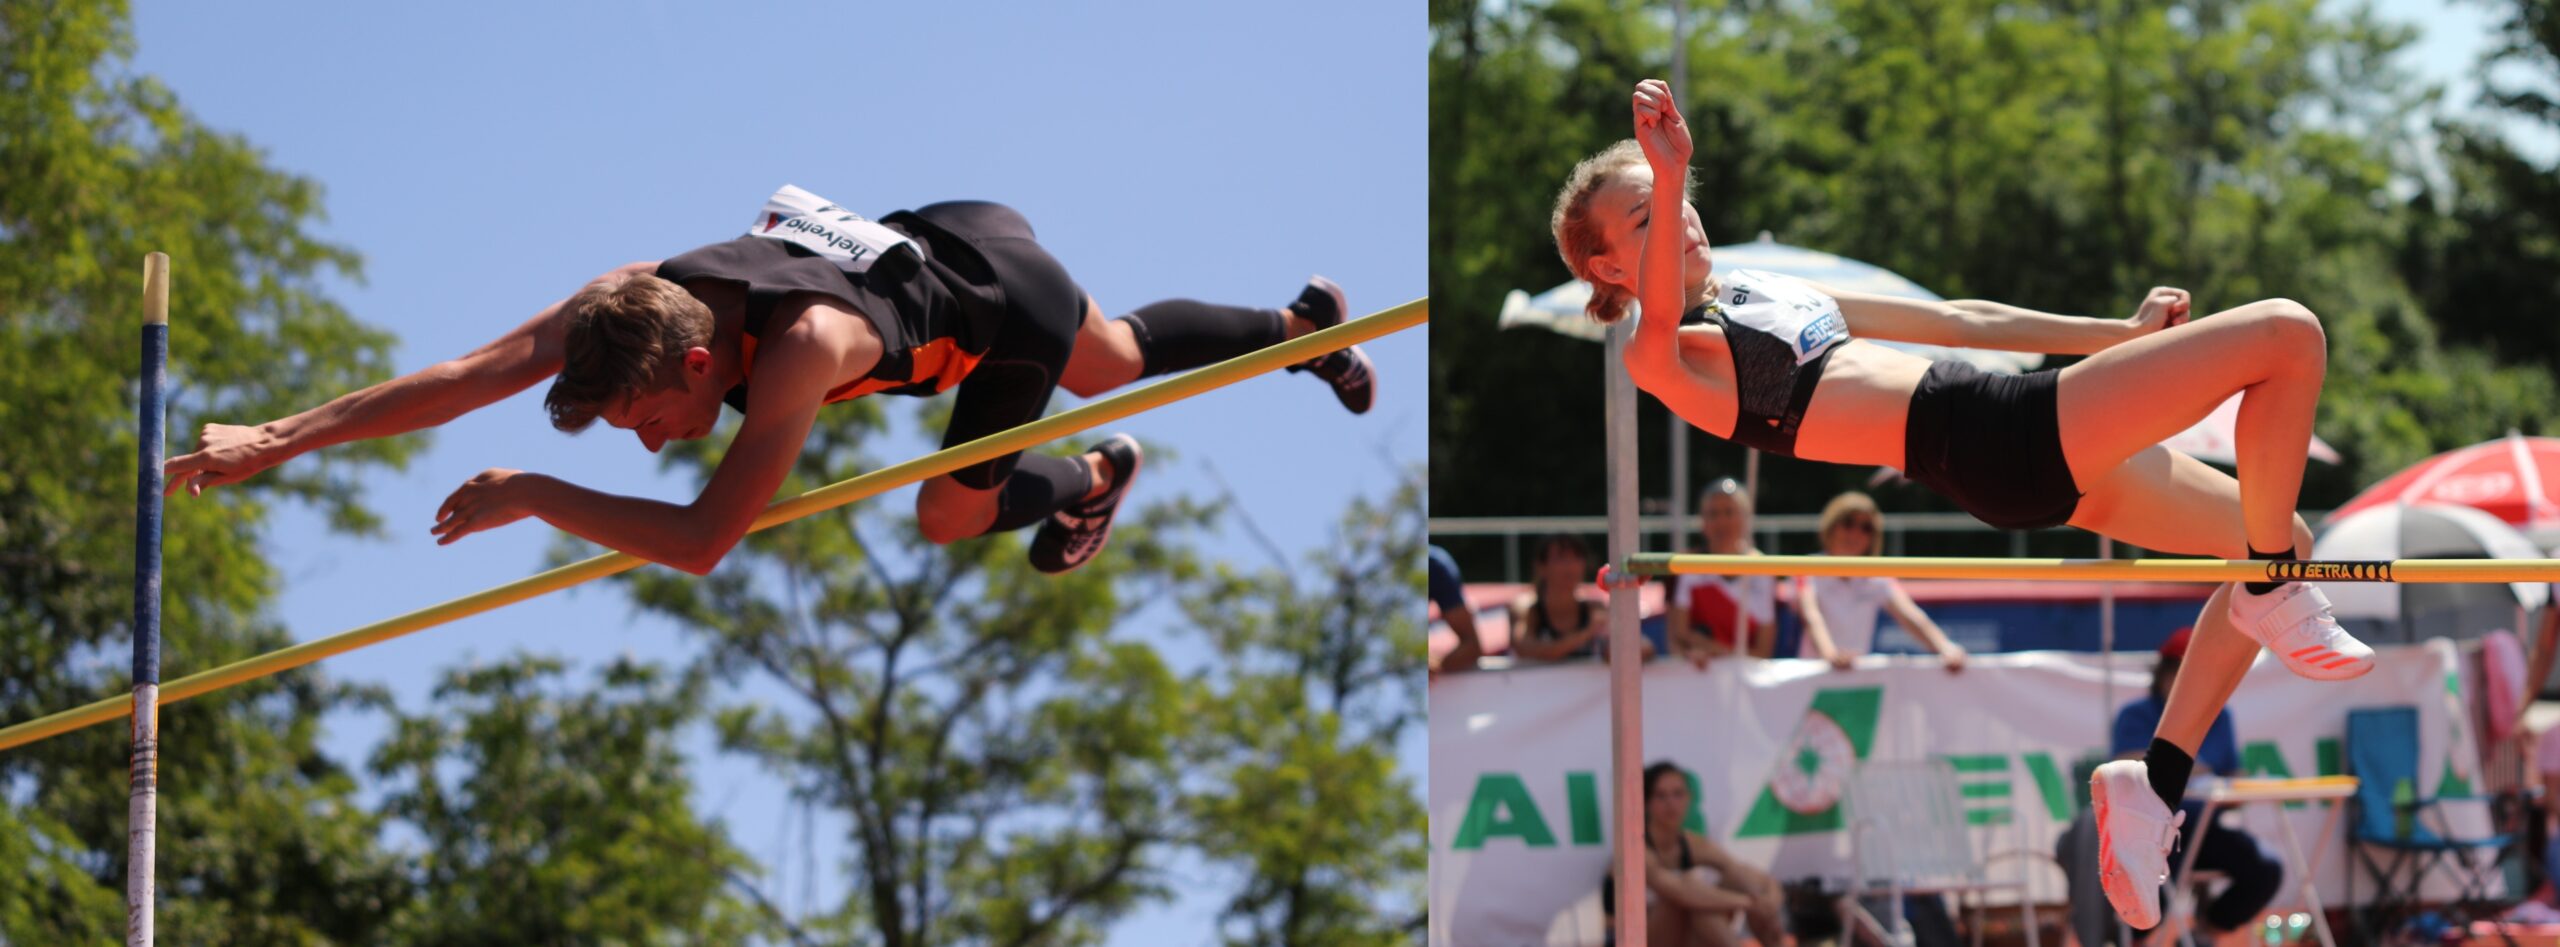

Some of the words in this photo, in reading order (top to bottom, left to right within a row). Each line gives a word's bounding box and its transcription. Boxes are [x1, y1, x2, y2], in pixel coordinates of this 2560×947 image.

[786, 217, 868, 262] helvetia
[2305, 564, 2353, 579] GETRA
[2240, 736, 2343, 808] AI
